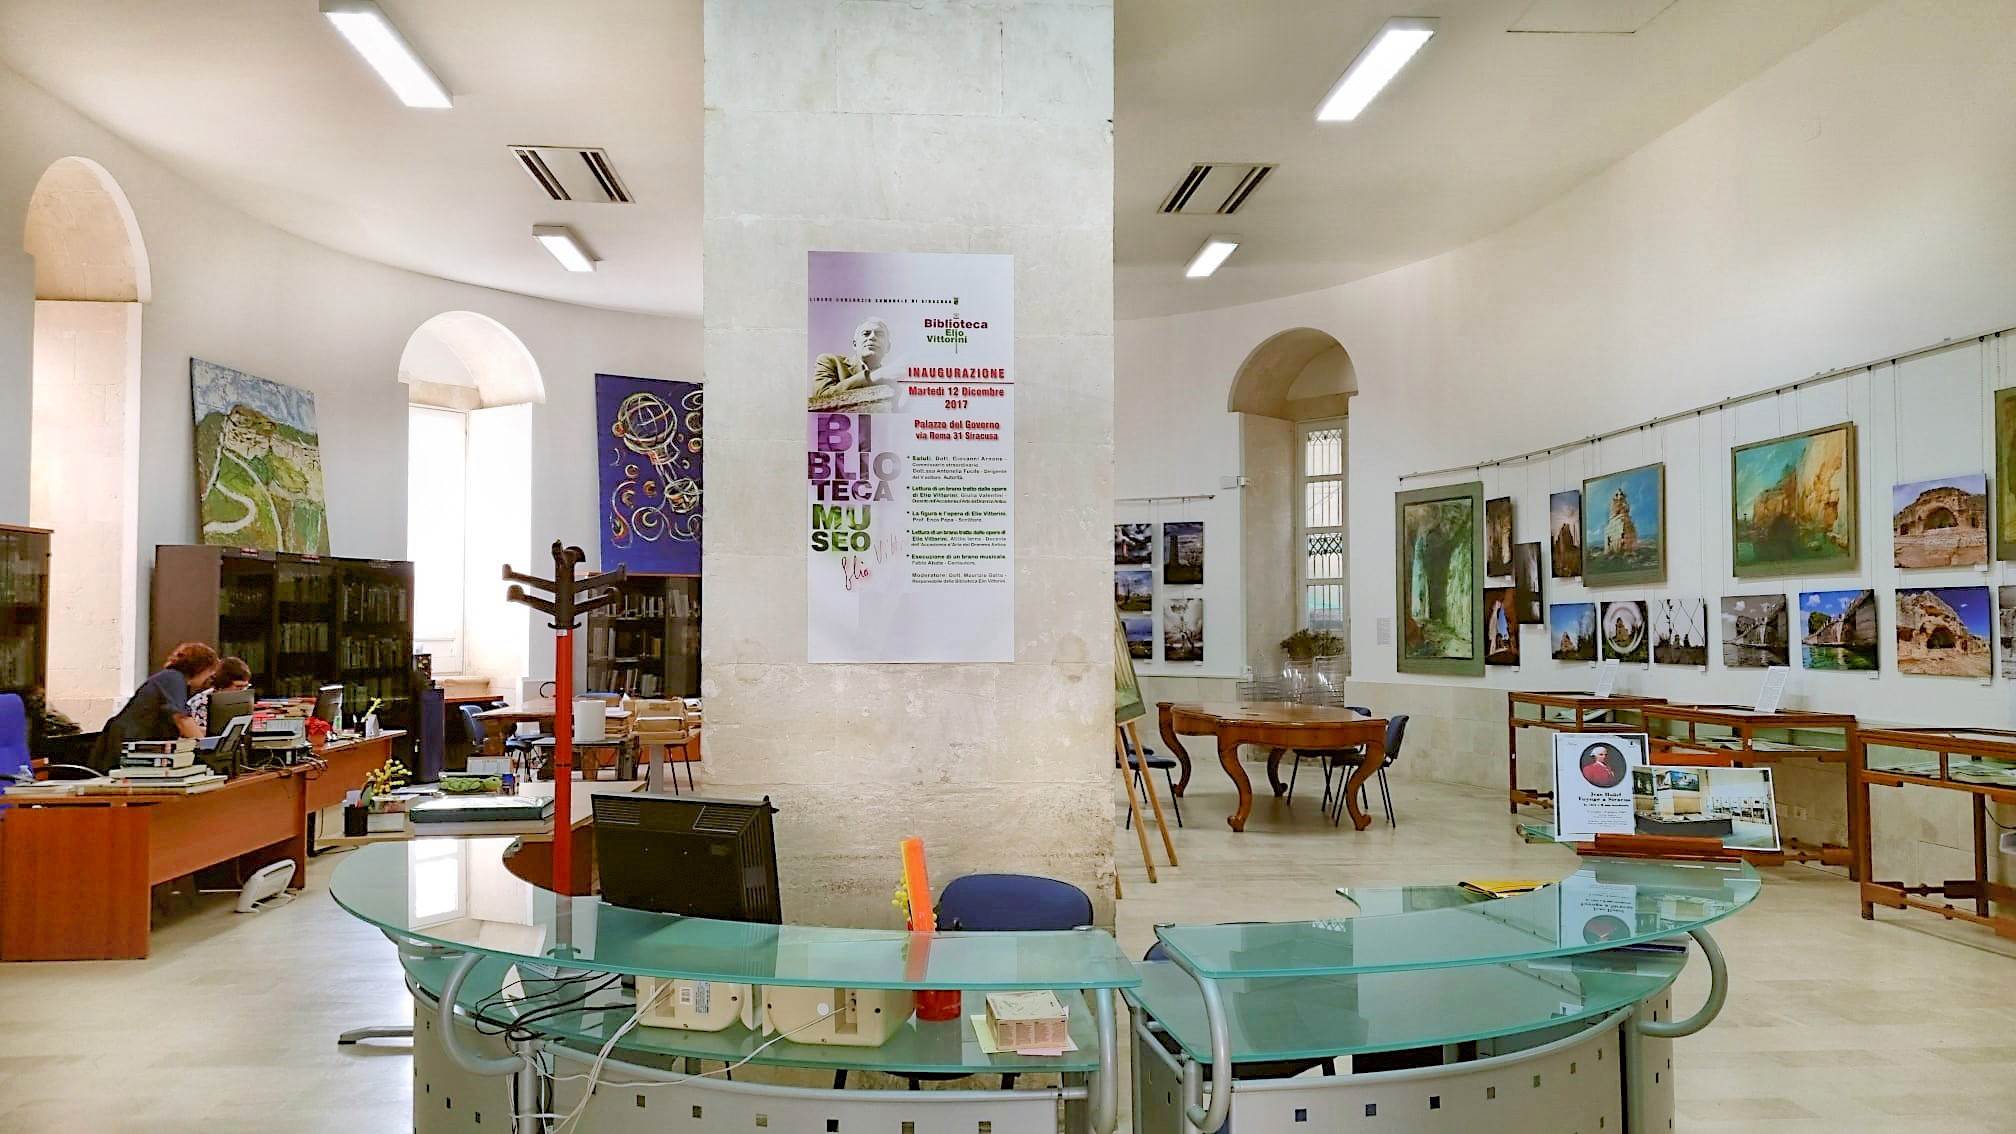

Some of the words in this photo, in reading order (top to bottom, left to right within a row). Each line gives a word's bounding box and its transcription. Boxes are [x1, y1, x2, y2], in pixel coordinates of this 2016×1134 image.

[924, 318, 988, 329] Biblioteca
[945, 329, 964, 337] Elio
[908, 367, 1005, 379] INAUGURAZIONE
[948, 387, 959, 396] 12
[962, 387, 1005, 397] Dicembre
[944, 400, 968, 409] 2017
[914, 419, 947, 429] Palazzo
[949, 420, 963, 429] del
[965, 420, 1000, 430] Governo
[818, 414, 872, 452] BI
[916, 432, 928, 440] via
[930, 432, 951, 440] Roma
[953, 432, 962, 440] 31
[965, 432, 999, 441] Siracusa
[808, 452, 902, 480] BLIO
[812, 480, 894, 501] TECA
[812, 504, 871, 530] MU
[812, 531, 871, 552] SEO
